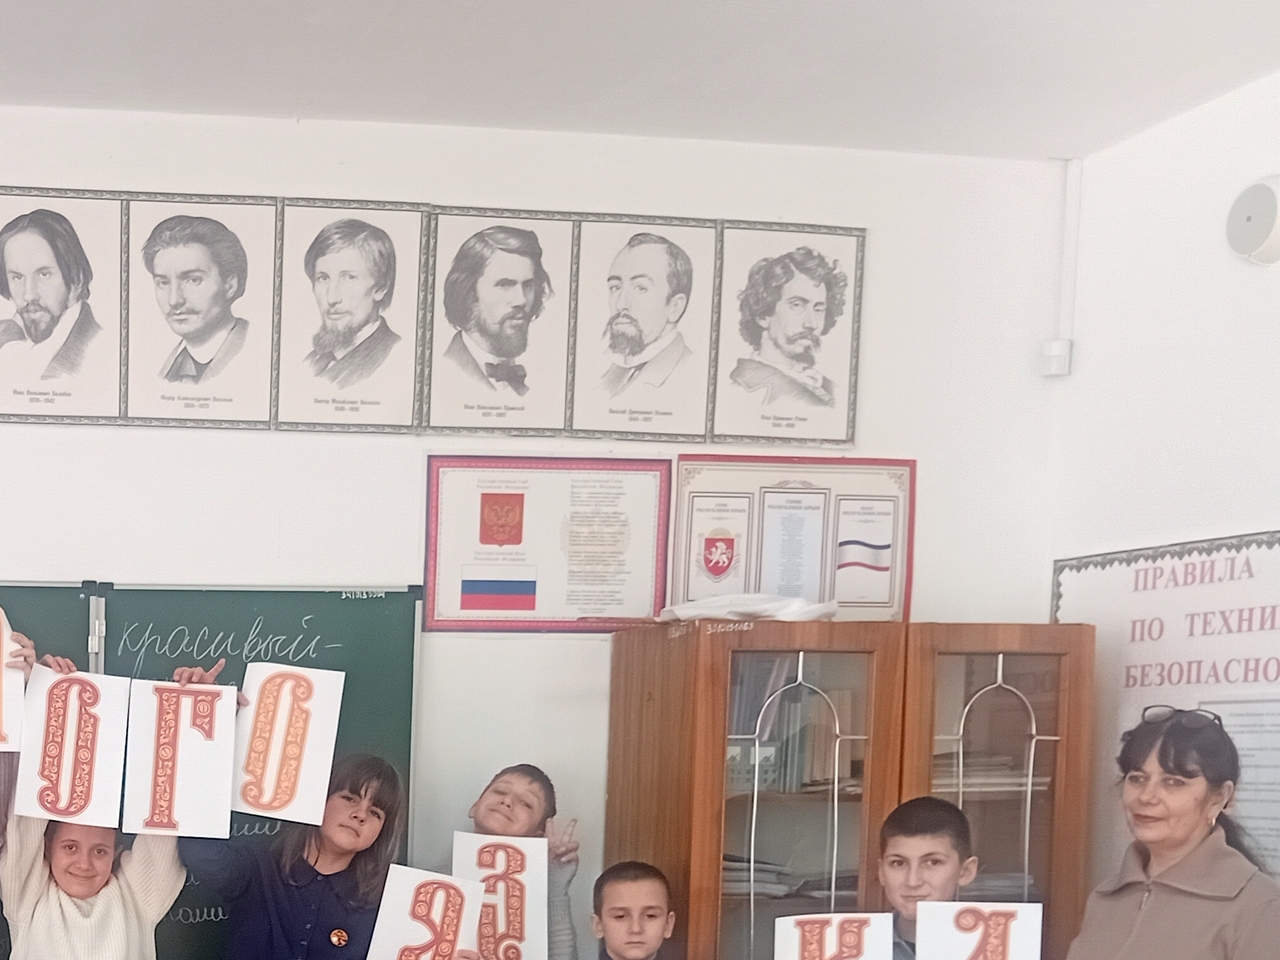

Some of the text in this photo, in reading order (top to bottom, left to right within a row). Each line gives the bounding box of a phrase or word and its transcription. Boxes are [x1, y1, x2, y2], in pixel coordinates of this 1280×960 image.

[1132, 555, 1254, 592] ПРАВИЛА
[1129, 617, 1164, 643] ПО
[1123, 657, 1280, 689] БЕЗОПАСНО
[143, 684, 223, 830] Г
